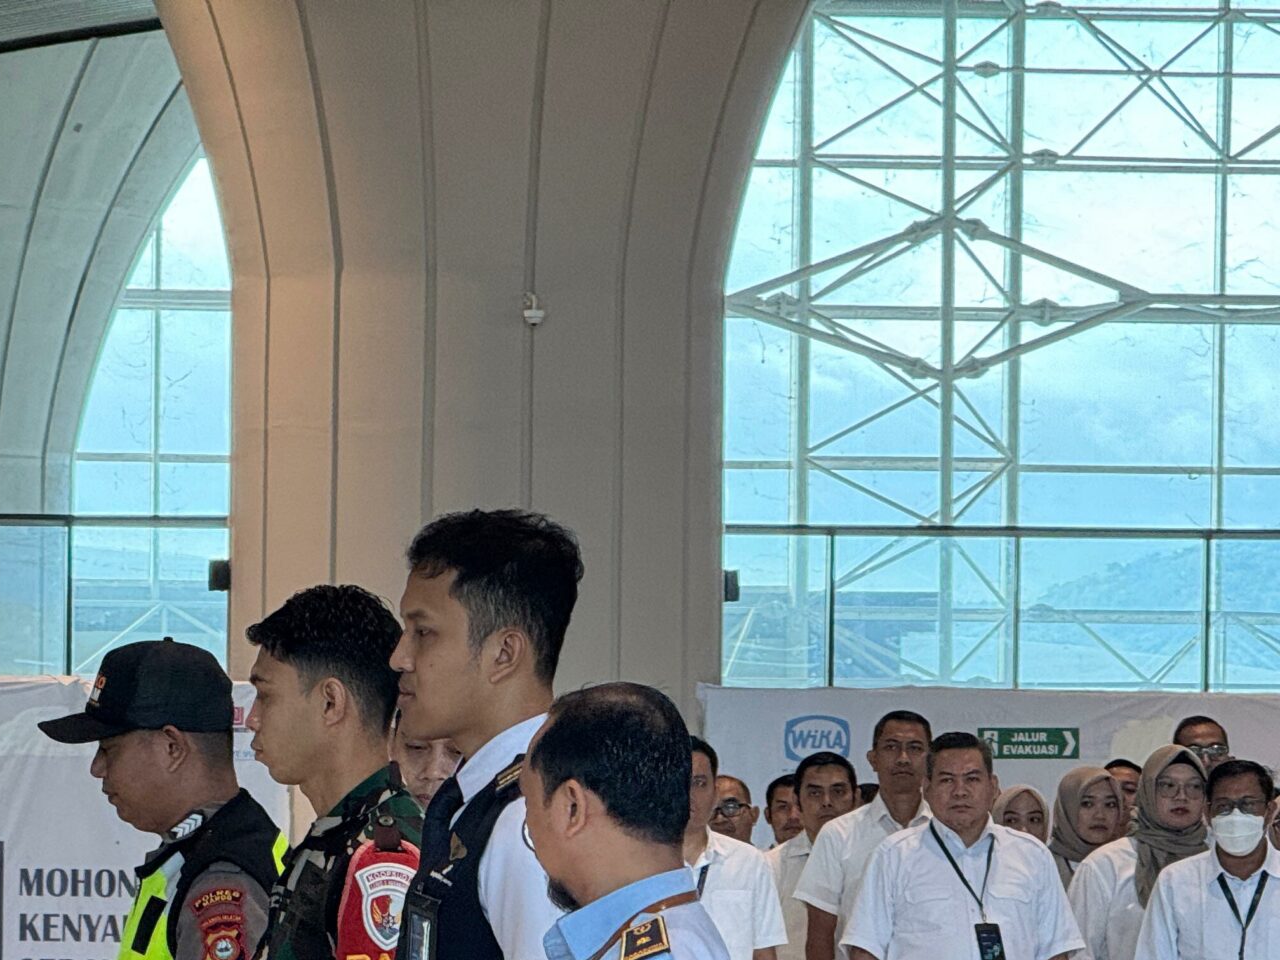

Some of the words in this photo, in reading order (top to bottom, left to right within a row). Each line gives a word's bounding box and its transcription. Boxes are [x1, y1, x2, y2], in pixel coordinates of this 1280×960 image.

[1010, 731, 1048, 743] JALUR
[1002, 744, 1059, 756] EVAKUASI
[18, 867, 138, 898] MOHON
[18, 912, 128, 943] KENYA
